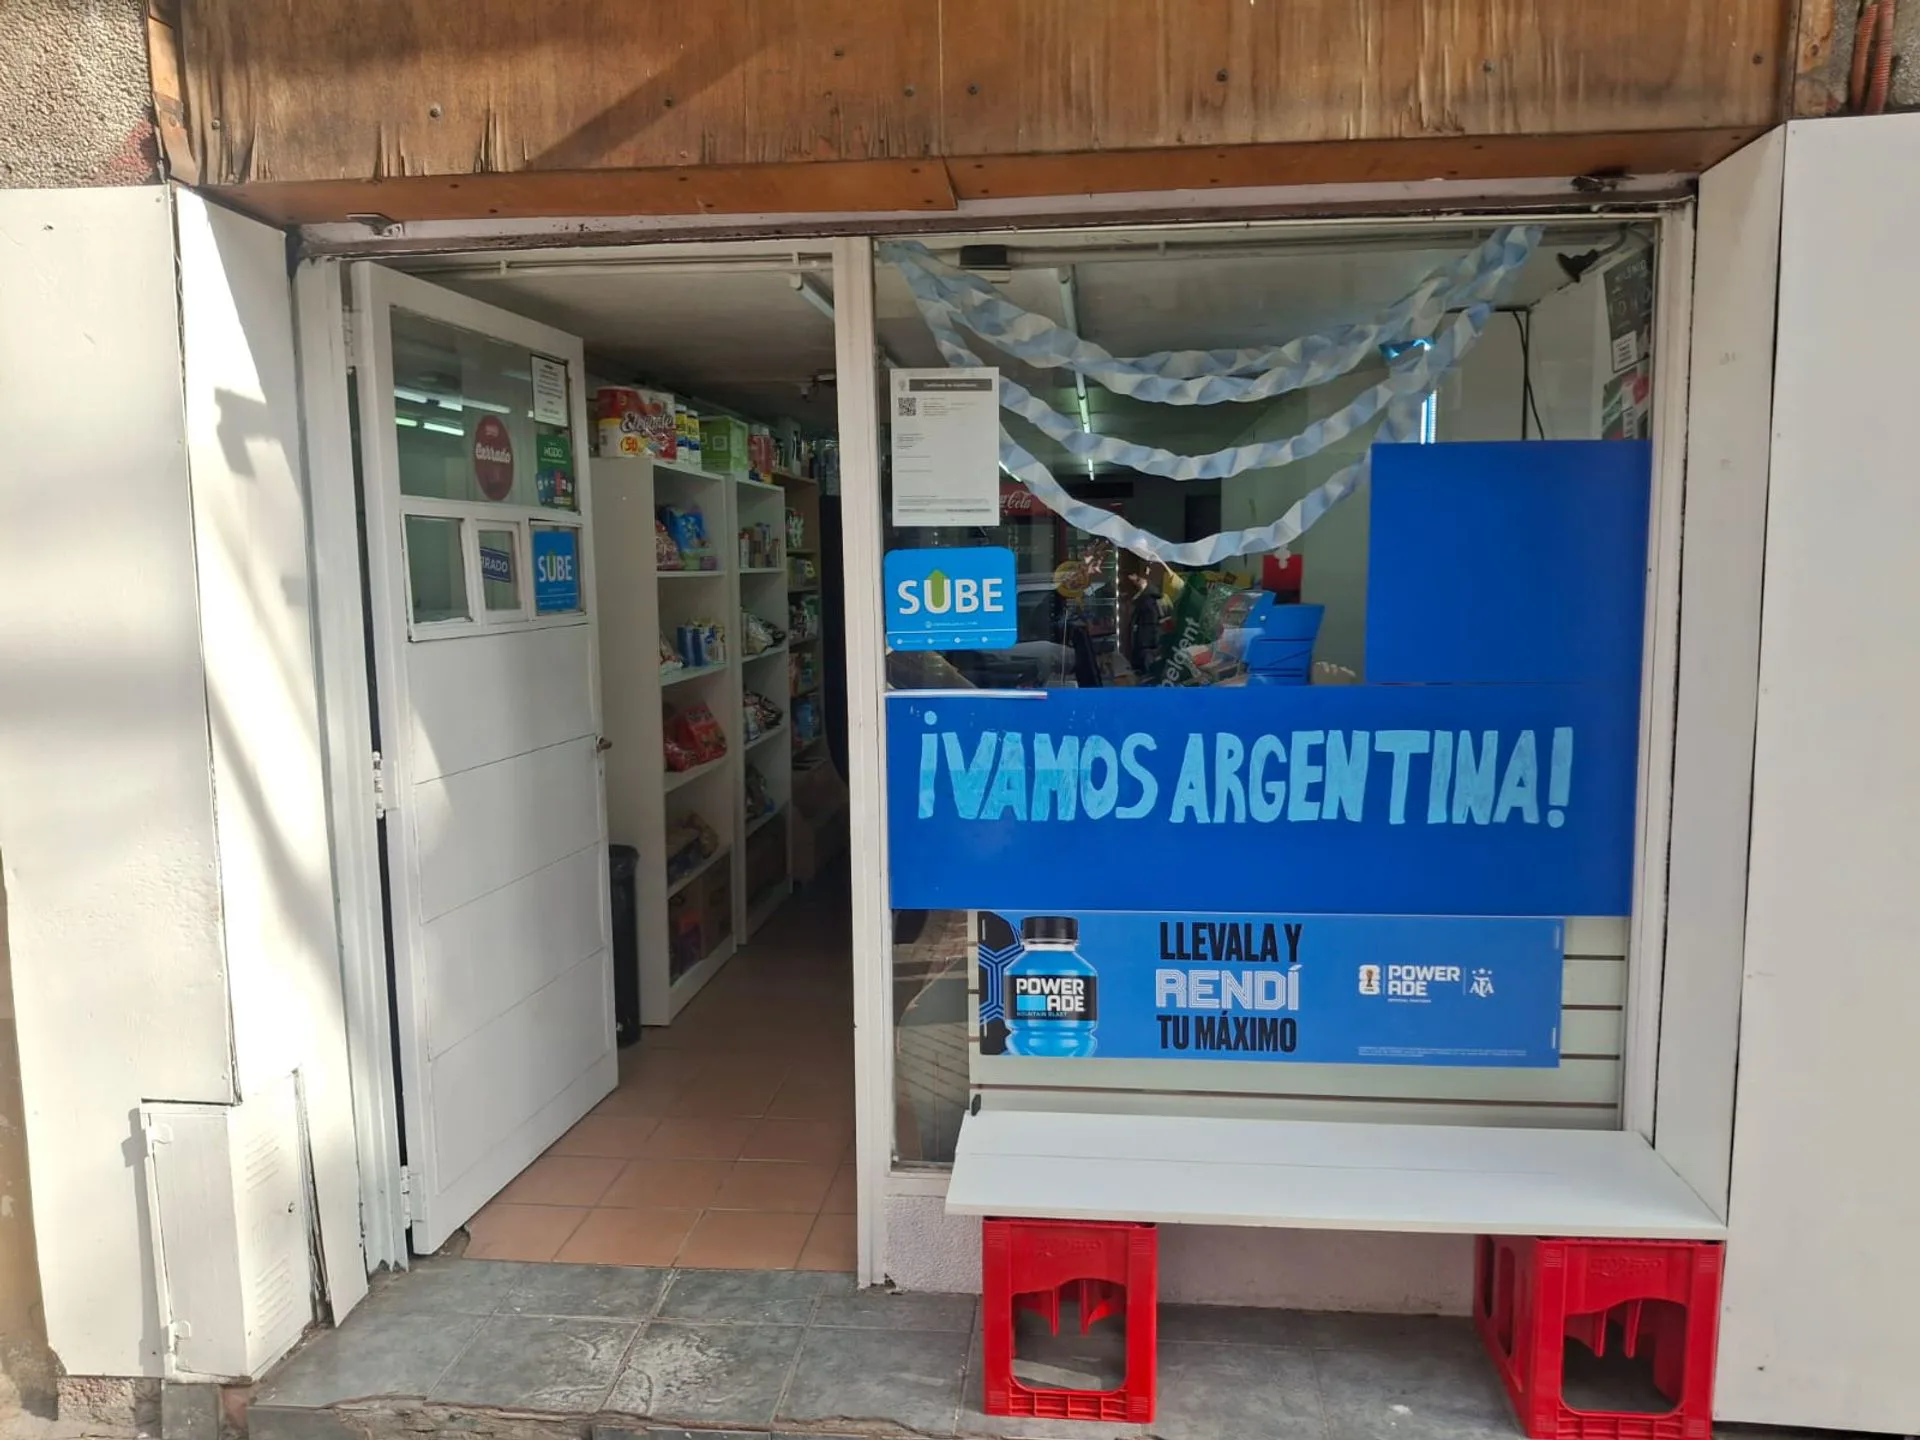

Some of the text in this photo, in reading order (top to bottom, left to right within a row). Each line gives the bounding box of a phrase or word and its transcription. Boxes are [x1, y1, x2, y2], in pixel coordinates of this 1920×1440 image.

[537, 554, 574, 583] SUBE
[897, 577, 1004, 615] SUBE
[917, 710, 1574, 829] ¡VAMOS ARGENTINA!
[1159, 921, 1303, 963] LLEVALA Y
[1015, 977, 1085, 995] POWER
[1155, 963, 1304, 1011] RENDÍ
[1387, 964, 1461, 982] POWER
[1387, 980, 1428, 997] ADE
[1045, 994, 1086, 1012] ADE
[1155, 1009, 1298, 1054] TU MÁXIMO
